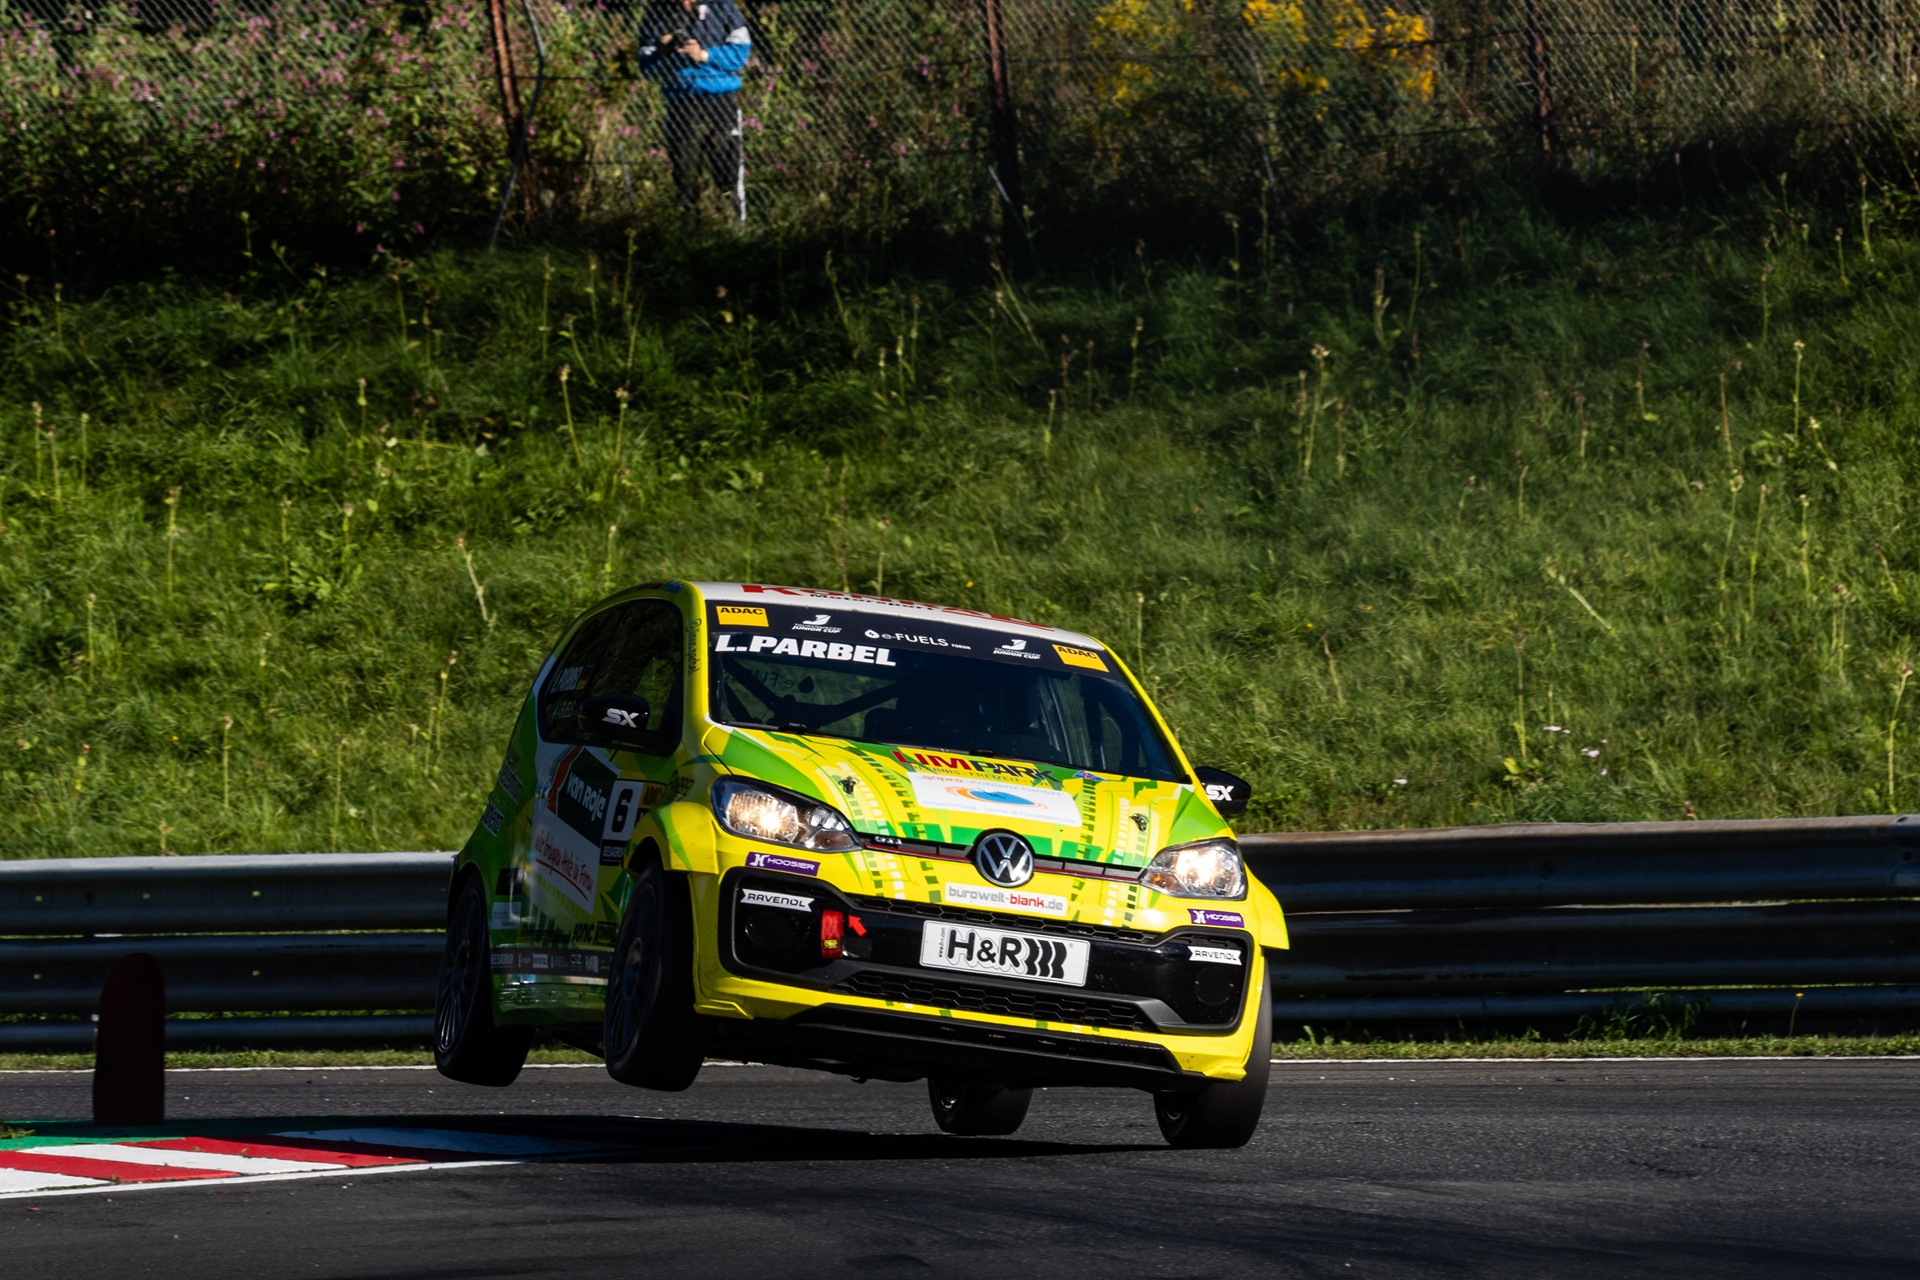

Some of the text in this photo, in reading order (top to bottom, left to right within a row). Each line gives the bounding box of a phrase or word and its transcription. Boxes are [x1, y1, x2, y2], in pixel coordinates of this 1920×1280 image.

[810, 593, 934, 611] Motorsport
[719, 606, 764, 615] ADAC
[791, 625, 821, 633] JUNIOR
[881, 632, 949, 647] e-FUELS
[714, 634, 897, 667] L.PARBEL
[993, 650, 1022, 658] JUNIOR
[1057, 646, 1098, 659] ADAC
[602, 707, 640, 728] SX
[892, 751, 1062, 783] LIMPARK
[566, 772, 585, 803] van
[1205, 785, 1235, 802] SX
[611, 788, 634, 833] 6
[767, 857, 816, 870] HOOSIER
[747, 892, 806, 908] RAVENOL
[948, 885, 1063, 911] bürowelt-blank.de
[1205, 913, 1242, 922] HOOSIER
[947, 928, 1022, 968] H&R
[1194, 948, 1238, 961] RAVENOL
